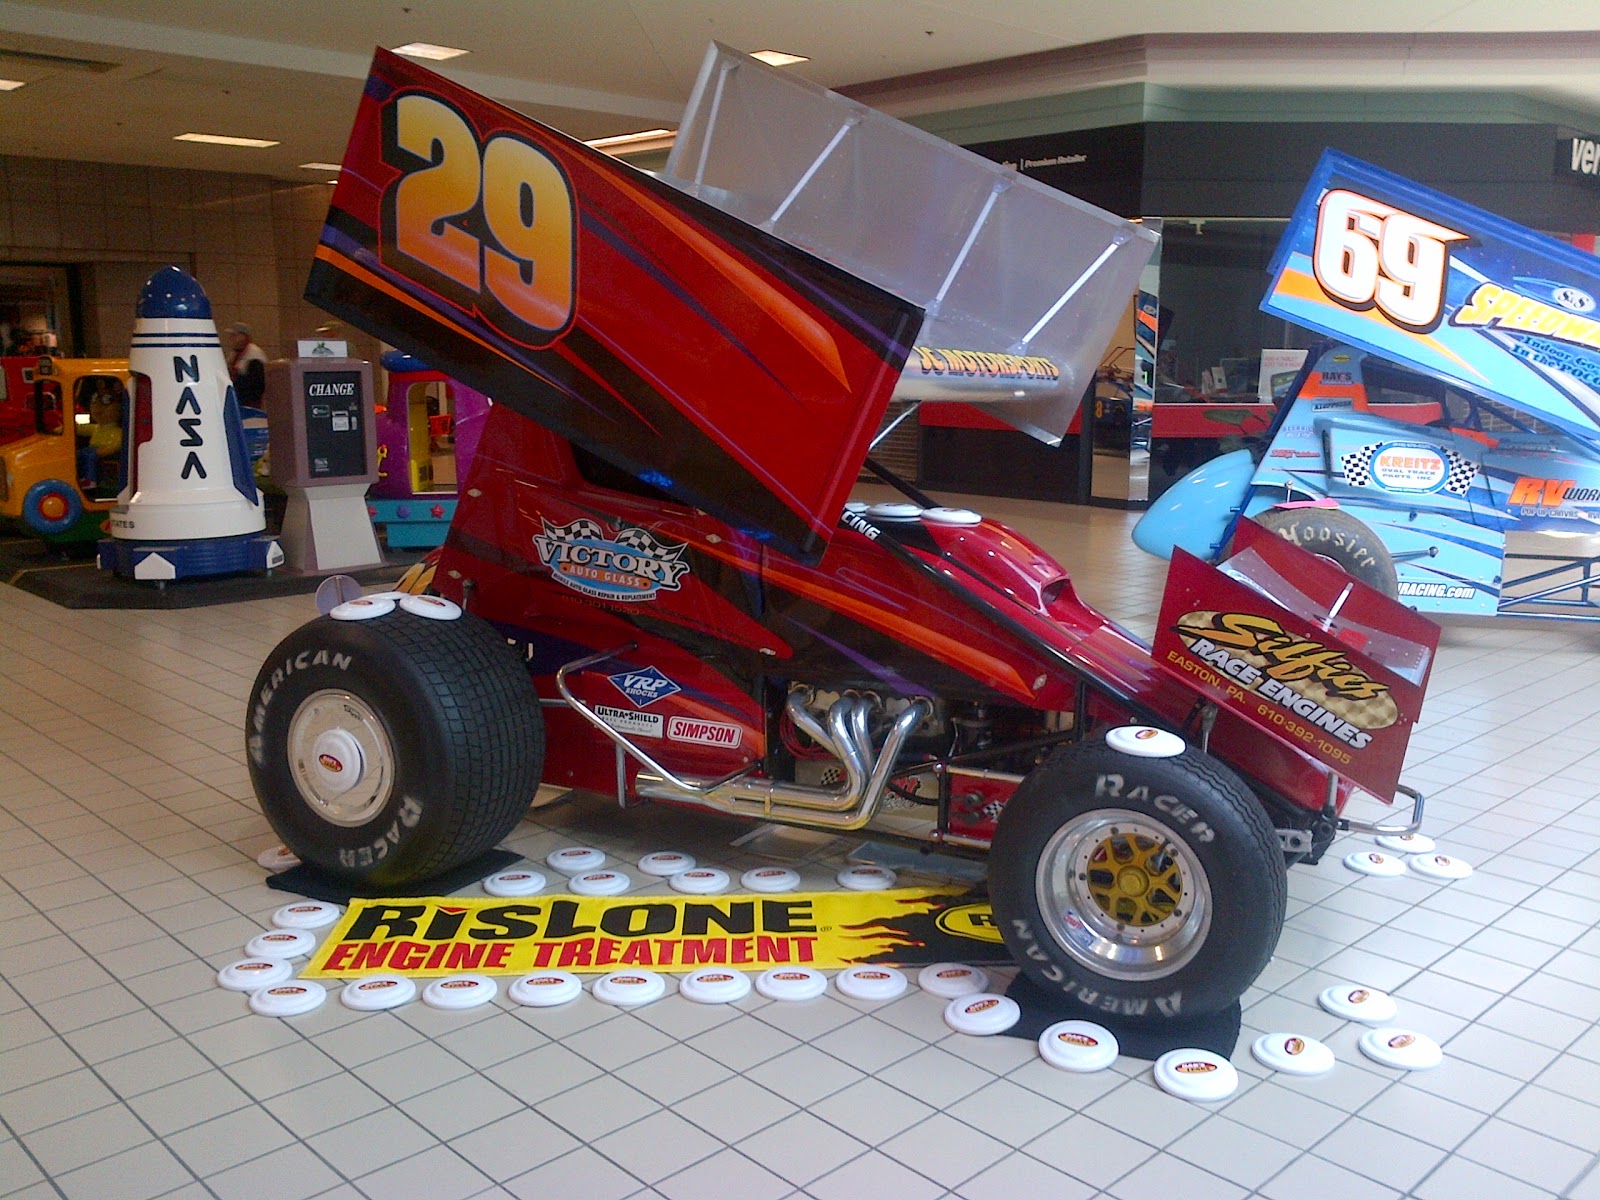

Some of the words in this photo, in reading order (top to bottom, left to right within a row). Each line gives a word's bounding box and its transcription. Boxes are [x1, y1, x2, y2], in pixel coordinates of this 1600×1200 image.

[395, 94, 576, 333] 29
[1313, 189, 1470, 334] 69
[309, 383, 354, 395] CHANGE
[173, 355, 206, 479] NASA
[1380, 455, 1441, 470] KREITZ
[1508, 477, 1577, 507] RV
[1279, 522, 1375, 567] Hoosier
[535, 537, 688, 588] VICTORY
[569, 564, 598, 578] AUTO
[604, 571, 641, 587] GLASS
[622, 674, 668, 690] VRP
[624, 688, 658, 698] SHOCKS
[1190, 637, 1263, 686] RACE
[1258, 678, 1373, 749] ENGINES
[673, 721, 736, 744] SIMPSON
[1094, 773, 1216, 843] RACER
[321, 944, 513, 972] ENGINE
[531, 940, 818, 971] TREATMENT
